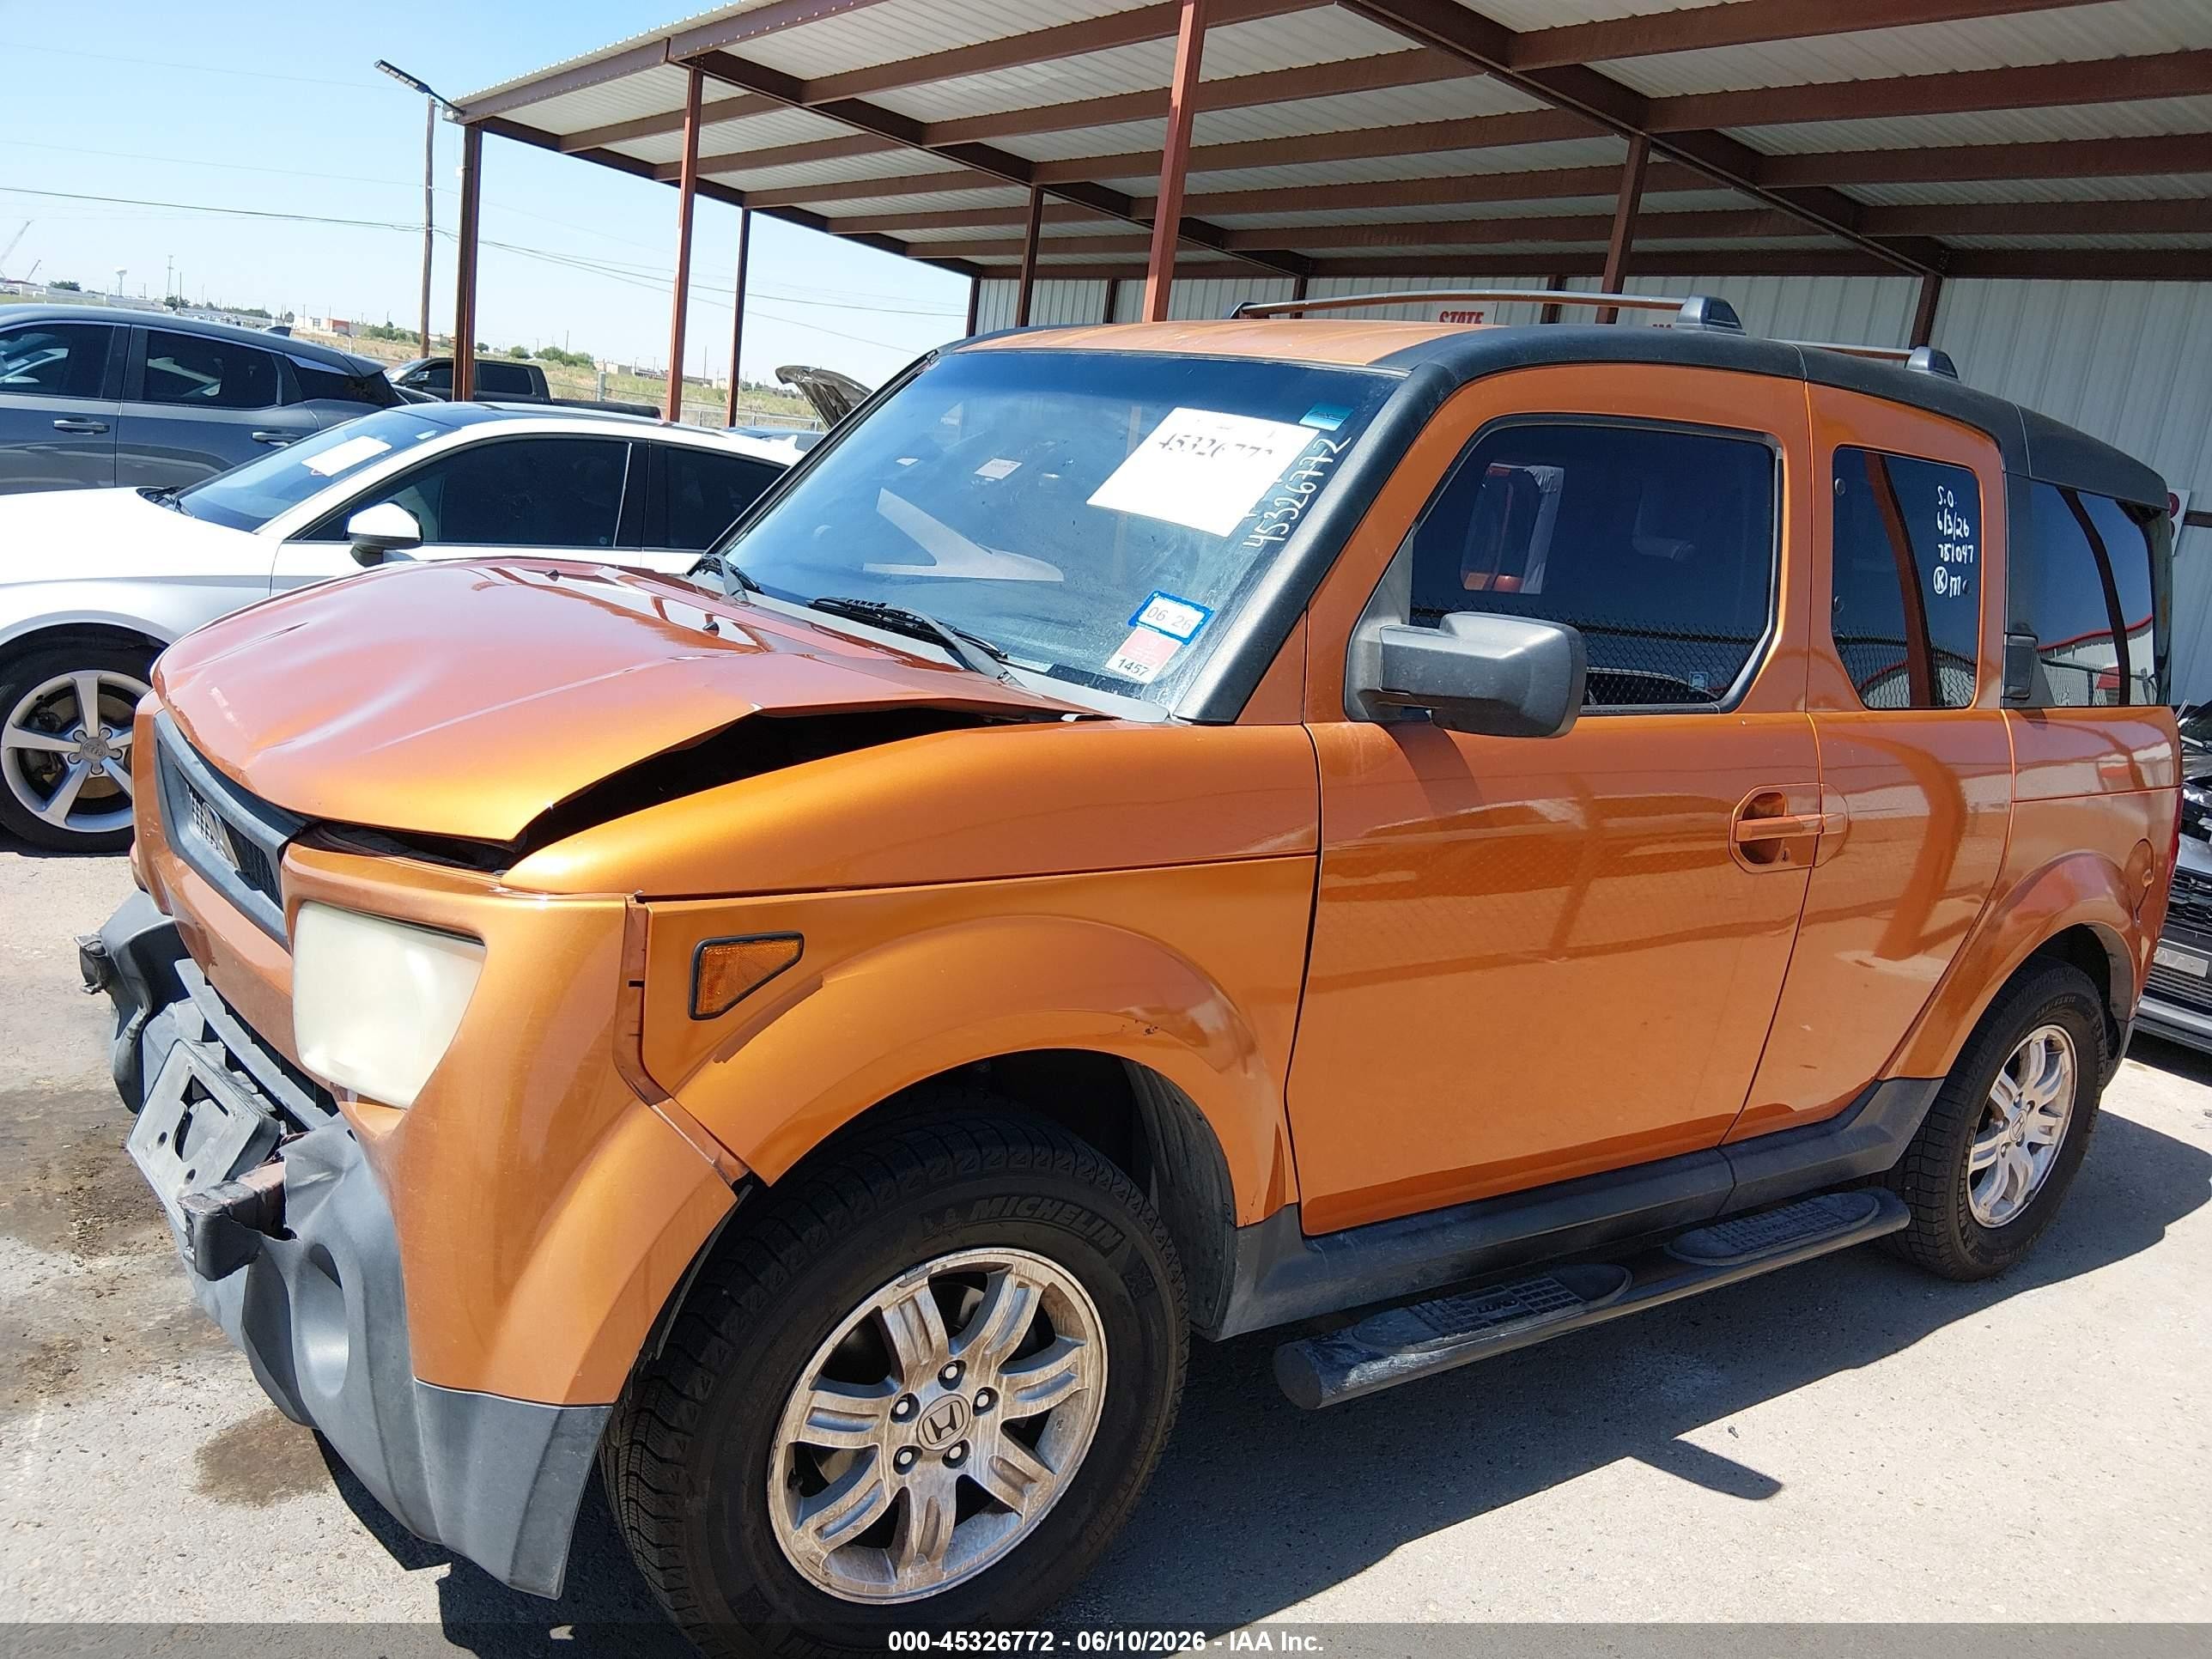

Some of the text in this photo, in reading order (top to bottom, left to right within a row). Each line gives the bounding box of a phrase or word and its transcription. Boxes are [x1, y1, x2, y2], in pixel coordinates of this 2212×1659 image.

[1439, 311, 1485, 325] STATE
[1243, 437, 1352, 547] 45326772
[1937, 507, 1970, 541] 6/3/26
[1938, 543, 1974, 564] 751047
[1146, 606, 1169, 622] 06
[1118, 658, 1149, 677] 1457
[970, 1196, 1124, 1251] MICHELIN
